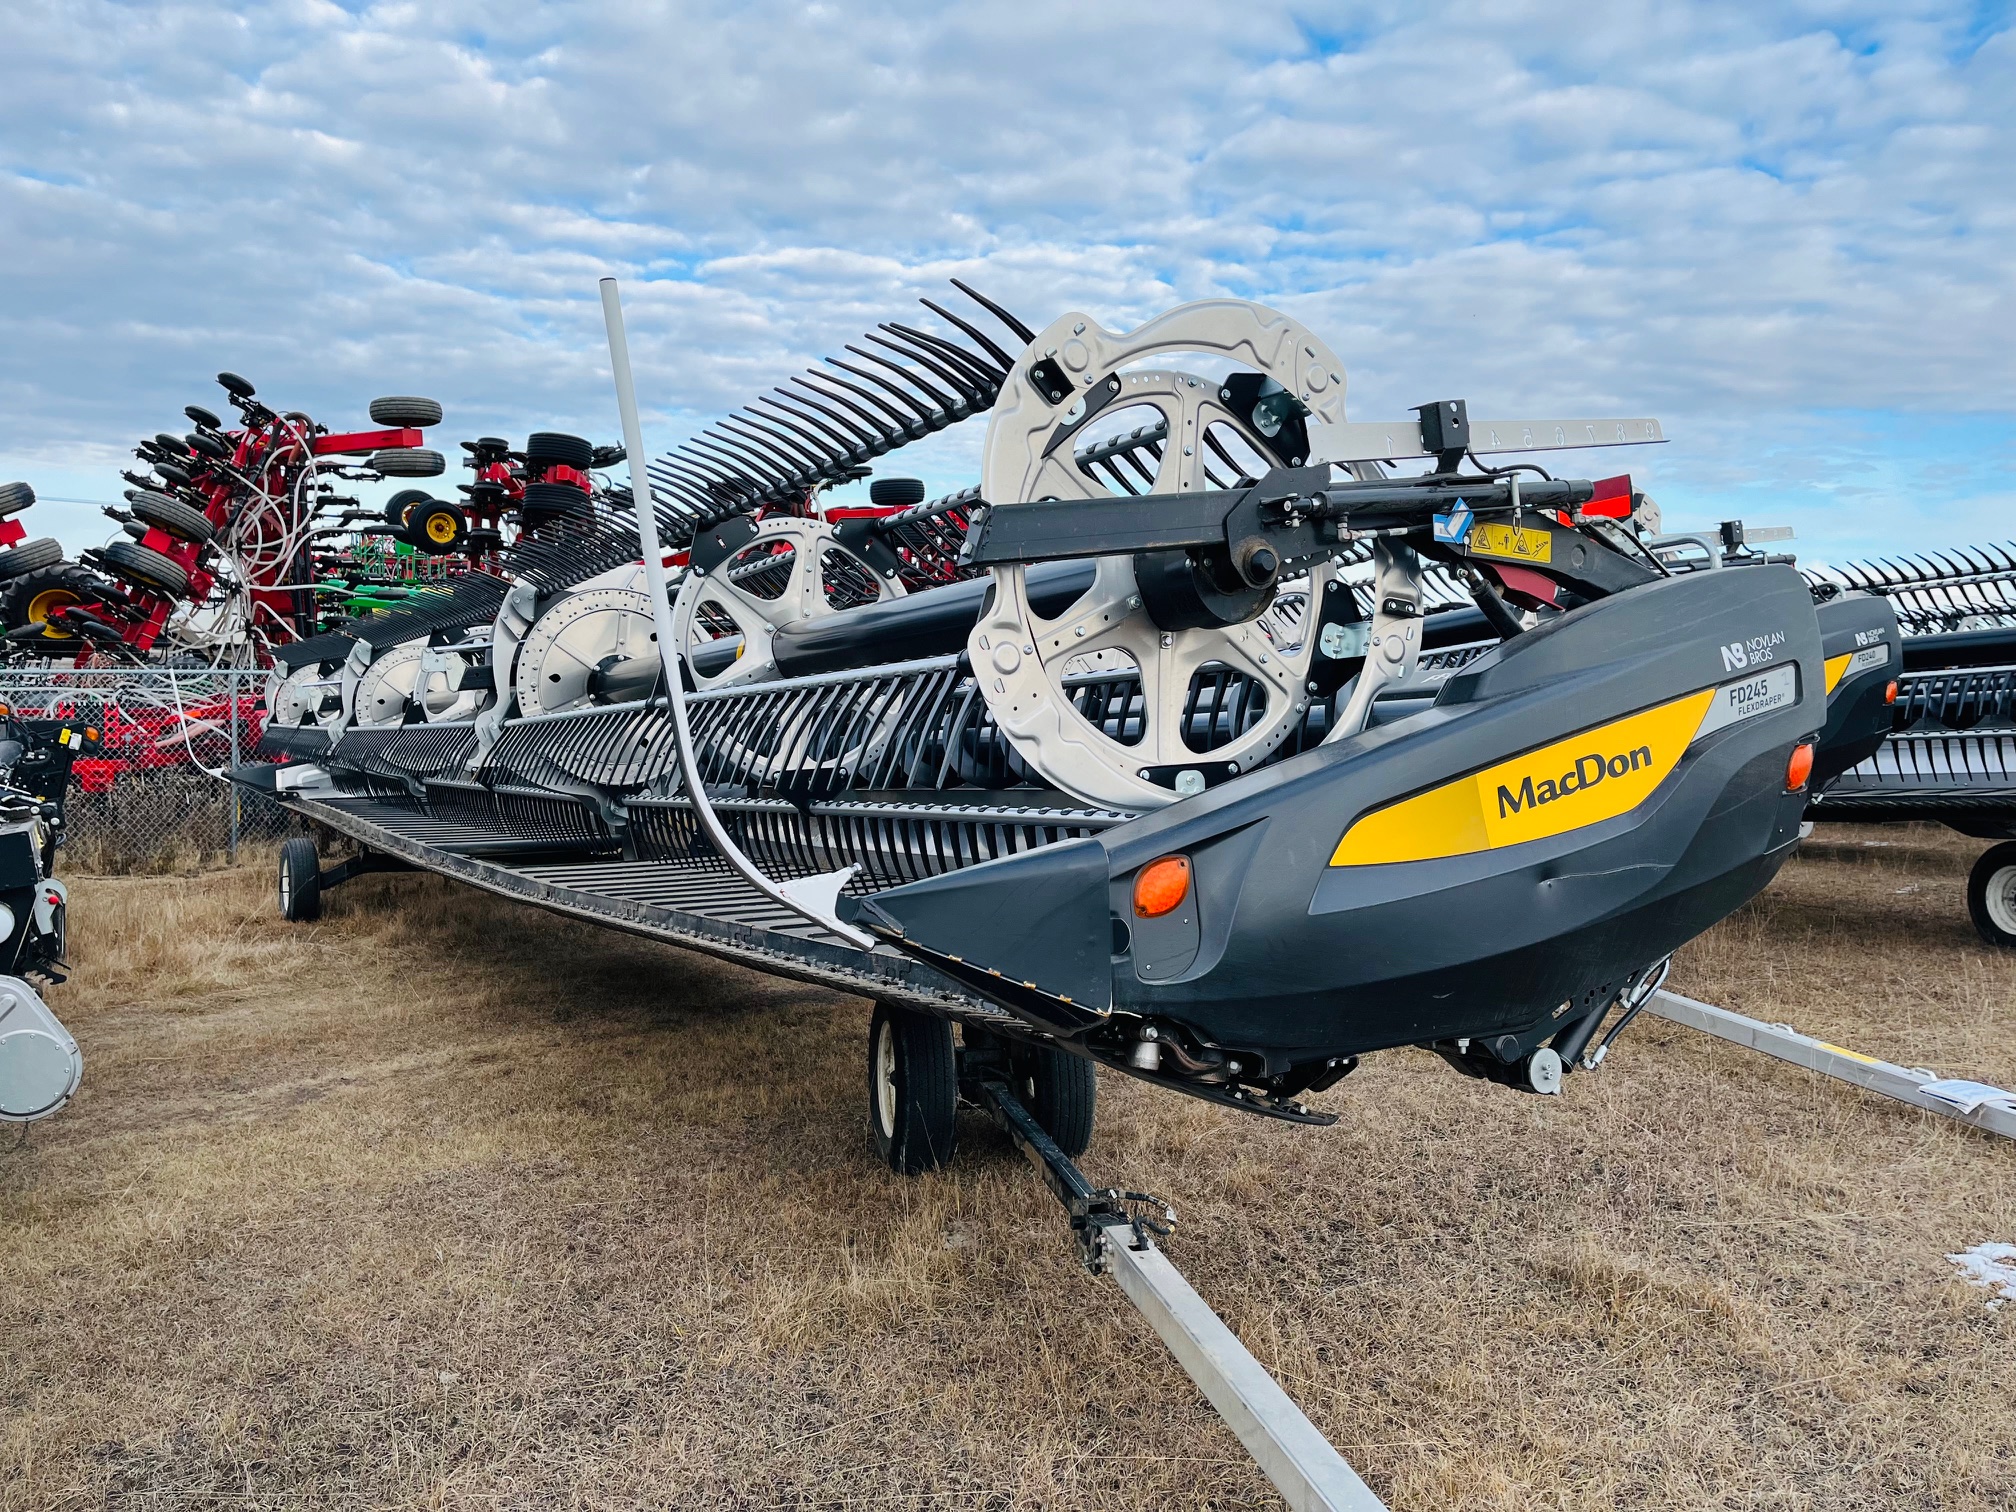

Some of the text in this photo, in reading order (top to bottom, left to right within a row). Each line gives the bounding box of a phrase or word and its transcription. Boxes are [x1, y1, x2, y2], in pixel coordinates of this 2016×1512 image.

[1746, 630, 1786, 652] NOVLAN
[1720, 642, 1748, 672] NB
[1749, 647, 1773, 665] BROS
[1729, 679, 1768, 707] FD245
[1497, 745, 1653, 820] MacDon
